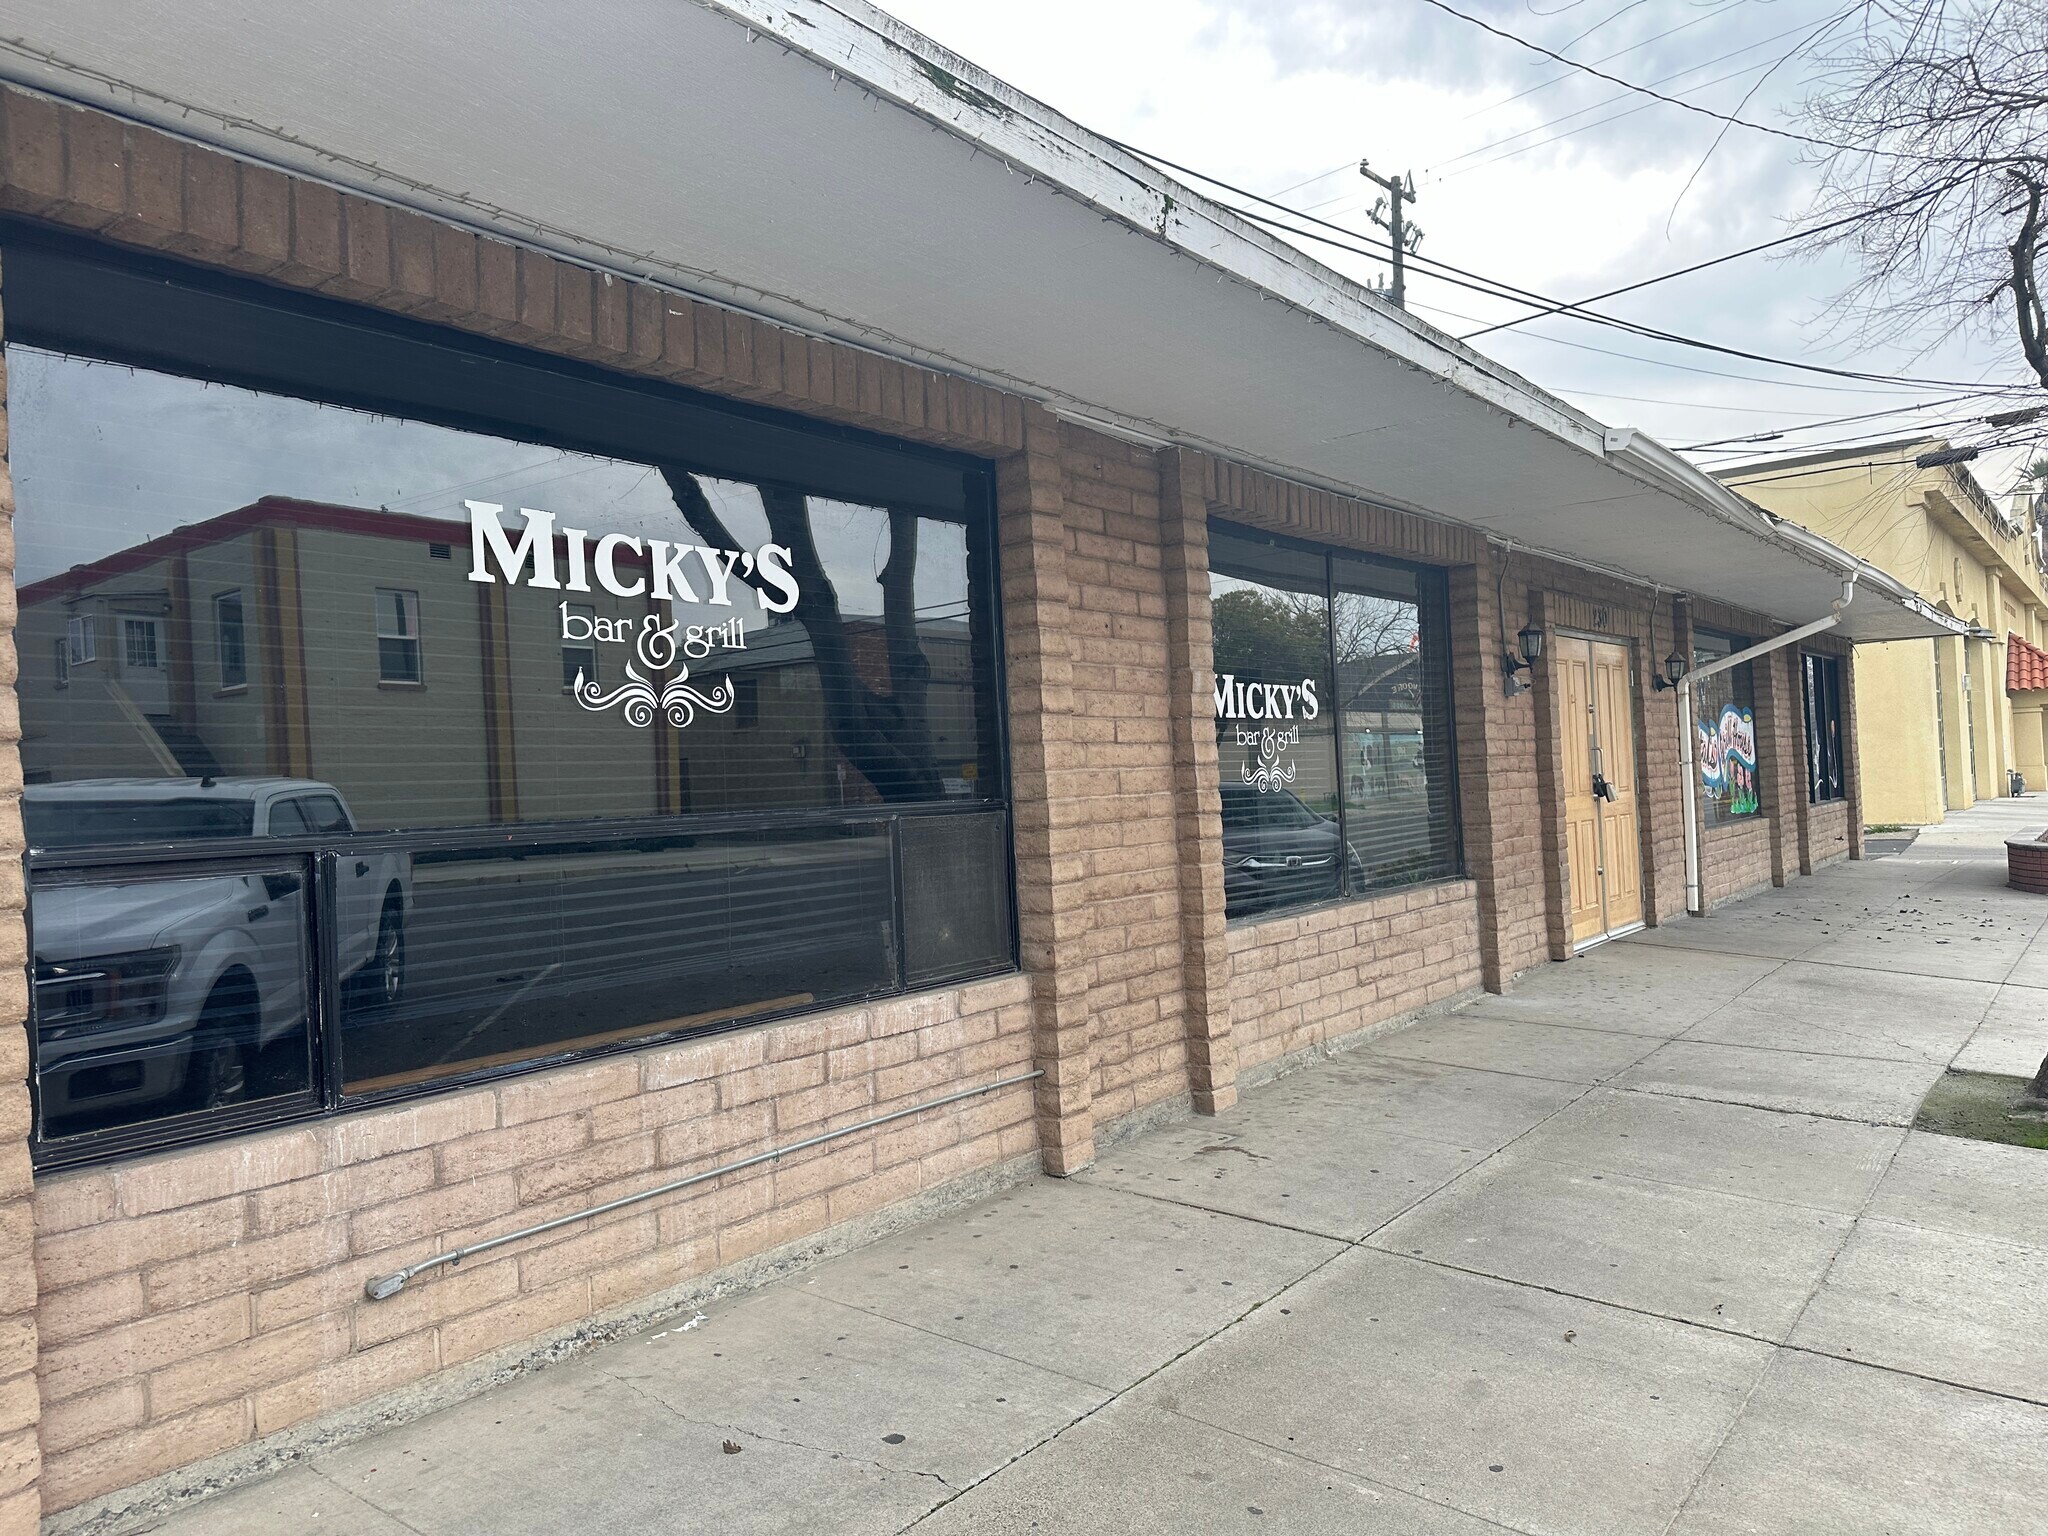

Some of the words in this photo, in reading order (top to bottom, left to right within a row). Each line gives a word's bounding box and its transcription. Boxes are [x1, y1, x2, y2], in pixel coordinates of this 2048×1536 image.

[464, 498, 800, 614] MICKY'S
[558, 600, 633, 643] bar
[636, 613, 680, 670] &
[683, 616, 748, 659] grill
[1235, 723, 1261, 746] bar
[1260, 726, 1276, 760] &
[1276, 724, 1300, 752] grill
